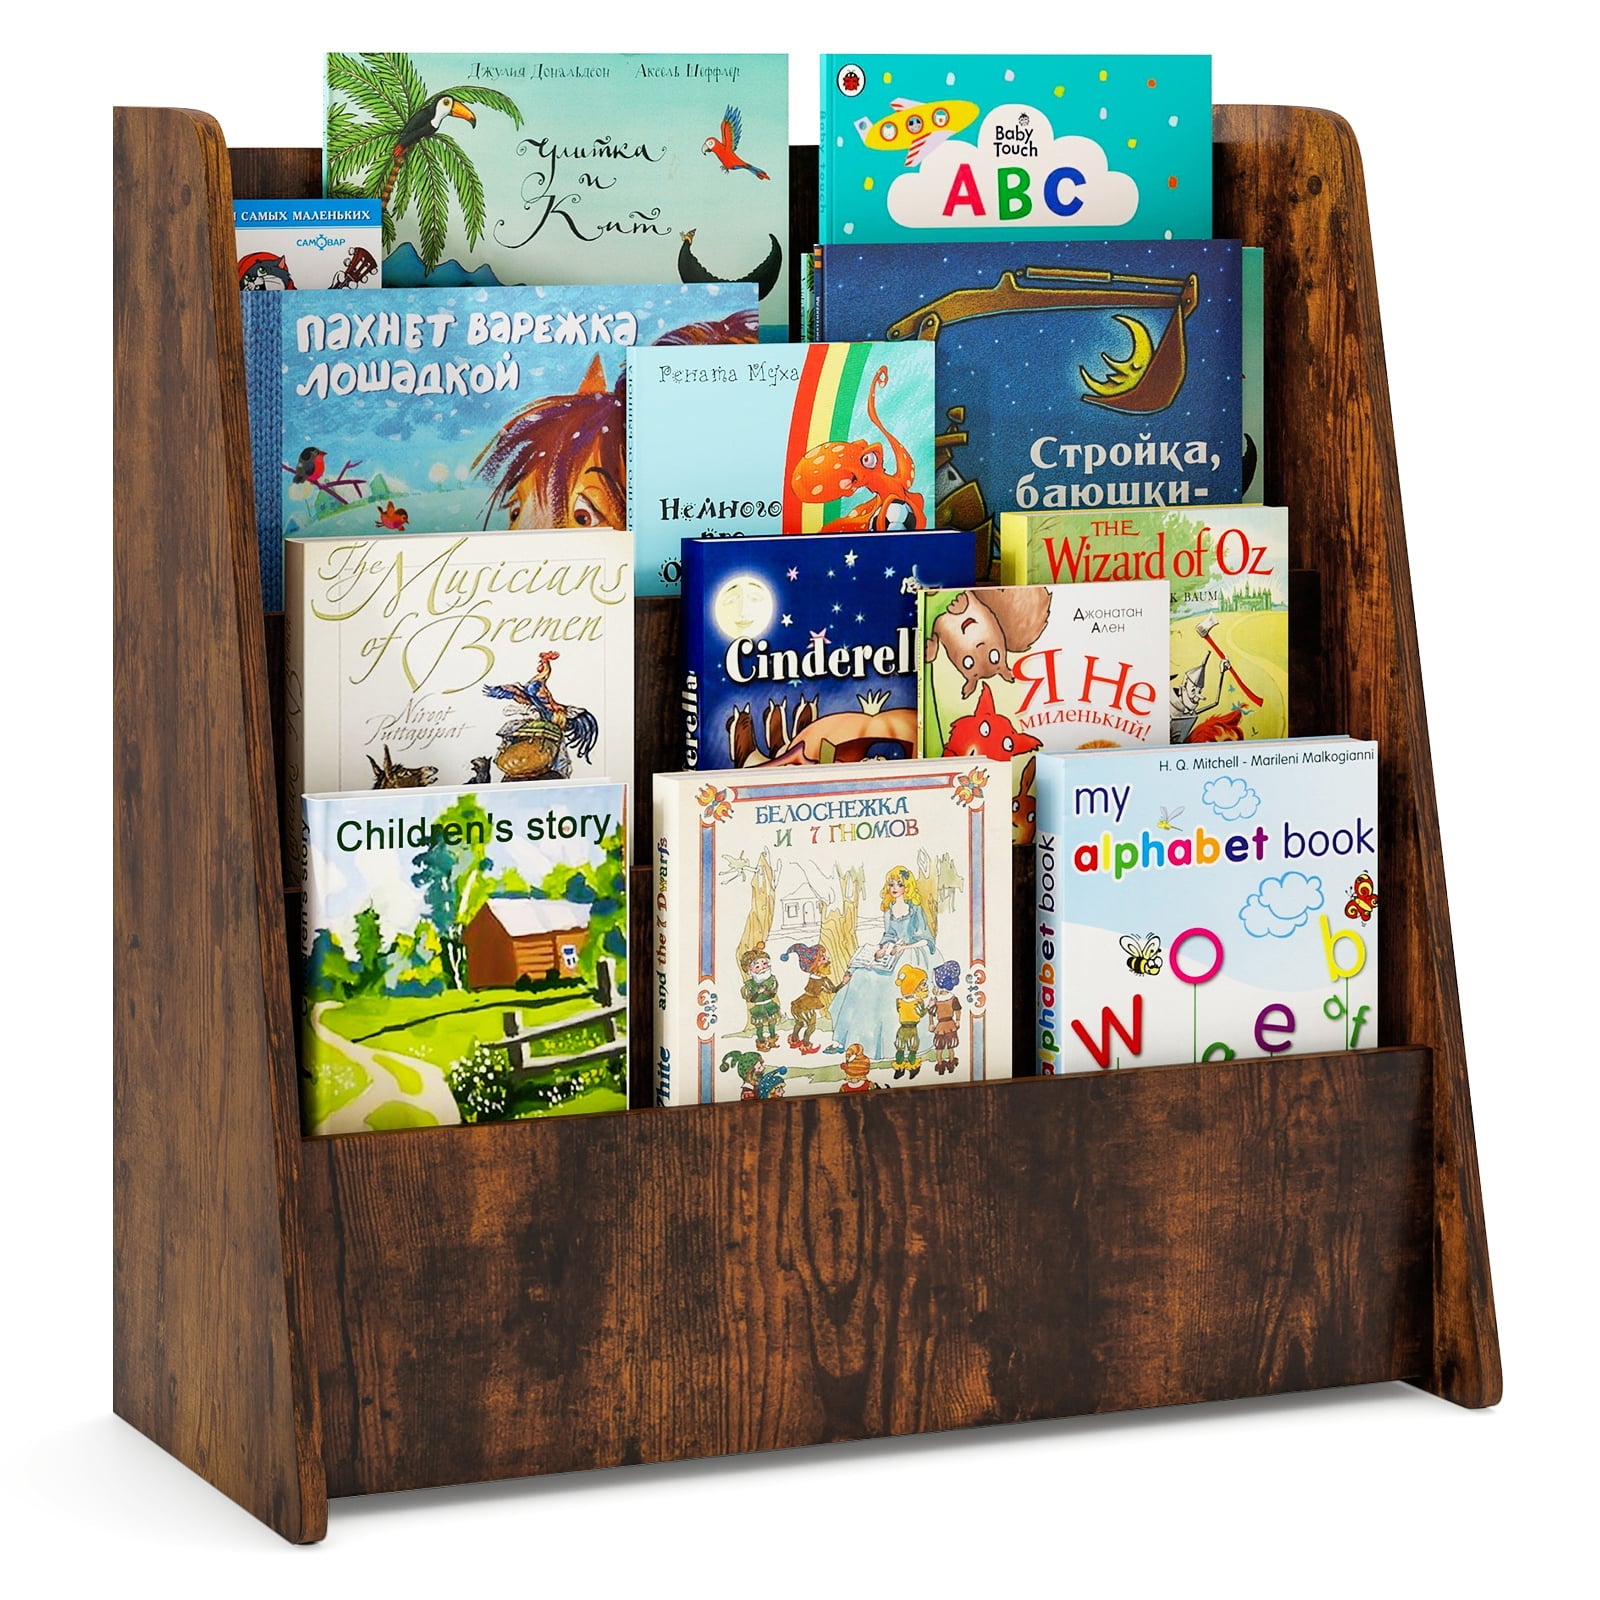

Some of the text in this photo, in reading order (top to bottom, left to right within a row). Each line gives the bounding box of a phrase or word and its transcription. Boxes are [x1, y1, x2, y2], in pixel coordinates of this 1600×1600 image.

[468, 62, 741, 82] Джулия Дональдсон Аксель Шеффлер
[993, 141, 1038, 158] Touch
[995, 125, 1033, 146] Baby
[579, 173, 617, 190] и
[241, 211, 288, 221] САМЫХ
[292, 210, 370, 221] МАЛЕНЬКИХ
[493, 194, 672, 248] Кит
[296, 236, 346, 249] САМОВАР
[659, 361, 799, 387] Рената Муха
[1030, 433, 1221, 474] Стройка,
[1015, 472, 1208, 508] баюшки-
[659, 497, 782, 521] Немного
[1091, 520, 1139, 537] THE
[318, 540, 388, 602] The
[1043, 526, 1274, 583] Wizard of Oz
[311, 537, 628, 621] Musicians
[1184, 591, 1217, 602] BAUM
[1073, 607, 1143, 622] Джонатан
[1091, 621, 1125, 633] Ален
[349, 599, 606, 694] of Bremen
[725, 627, 918, 682] Cinderell
[1011, 648, 1157, 716] Я Не
[1018, 708, 1152, 741] миленький!
[1159, 760, 1172, 772] H.
[1176, 759, 1189, 771] Q.
[1193, 756, 1239, 770] Mitchell
[1251, 753, 1299, 767] Marileni
[1302, 748, 1375, 765] Malkogianni
[755, 796, 909, 825] БЕЛОСНЕЖКА
[1075, 785, 1130, 822] my
[336, 809, 612, 852] Children's story
[774, 819, 920, 848] И 7 ГНОМОВ
[1073, 817, 1375, 880] alphabet book
[656, 836, 670, 912] Dwarfs
[1038, 834, 1055, 913] book
[656, 933, 667, 966] the
[656, 970, 669, 1010] and
